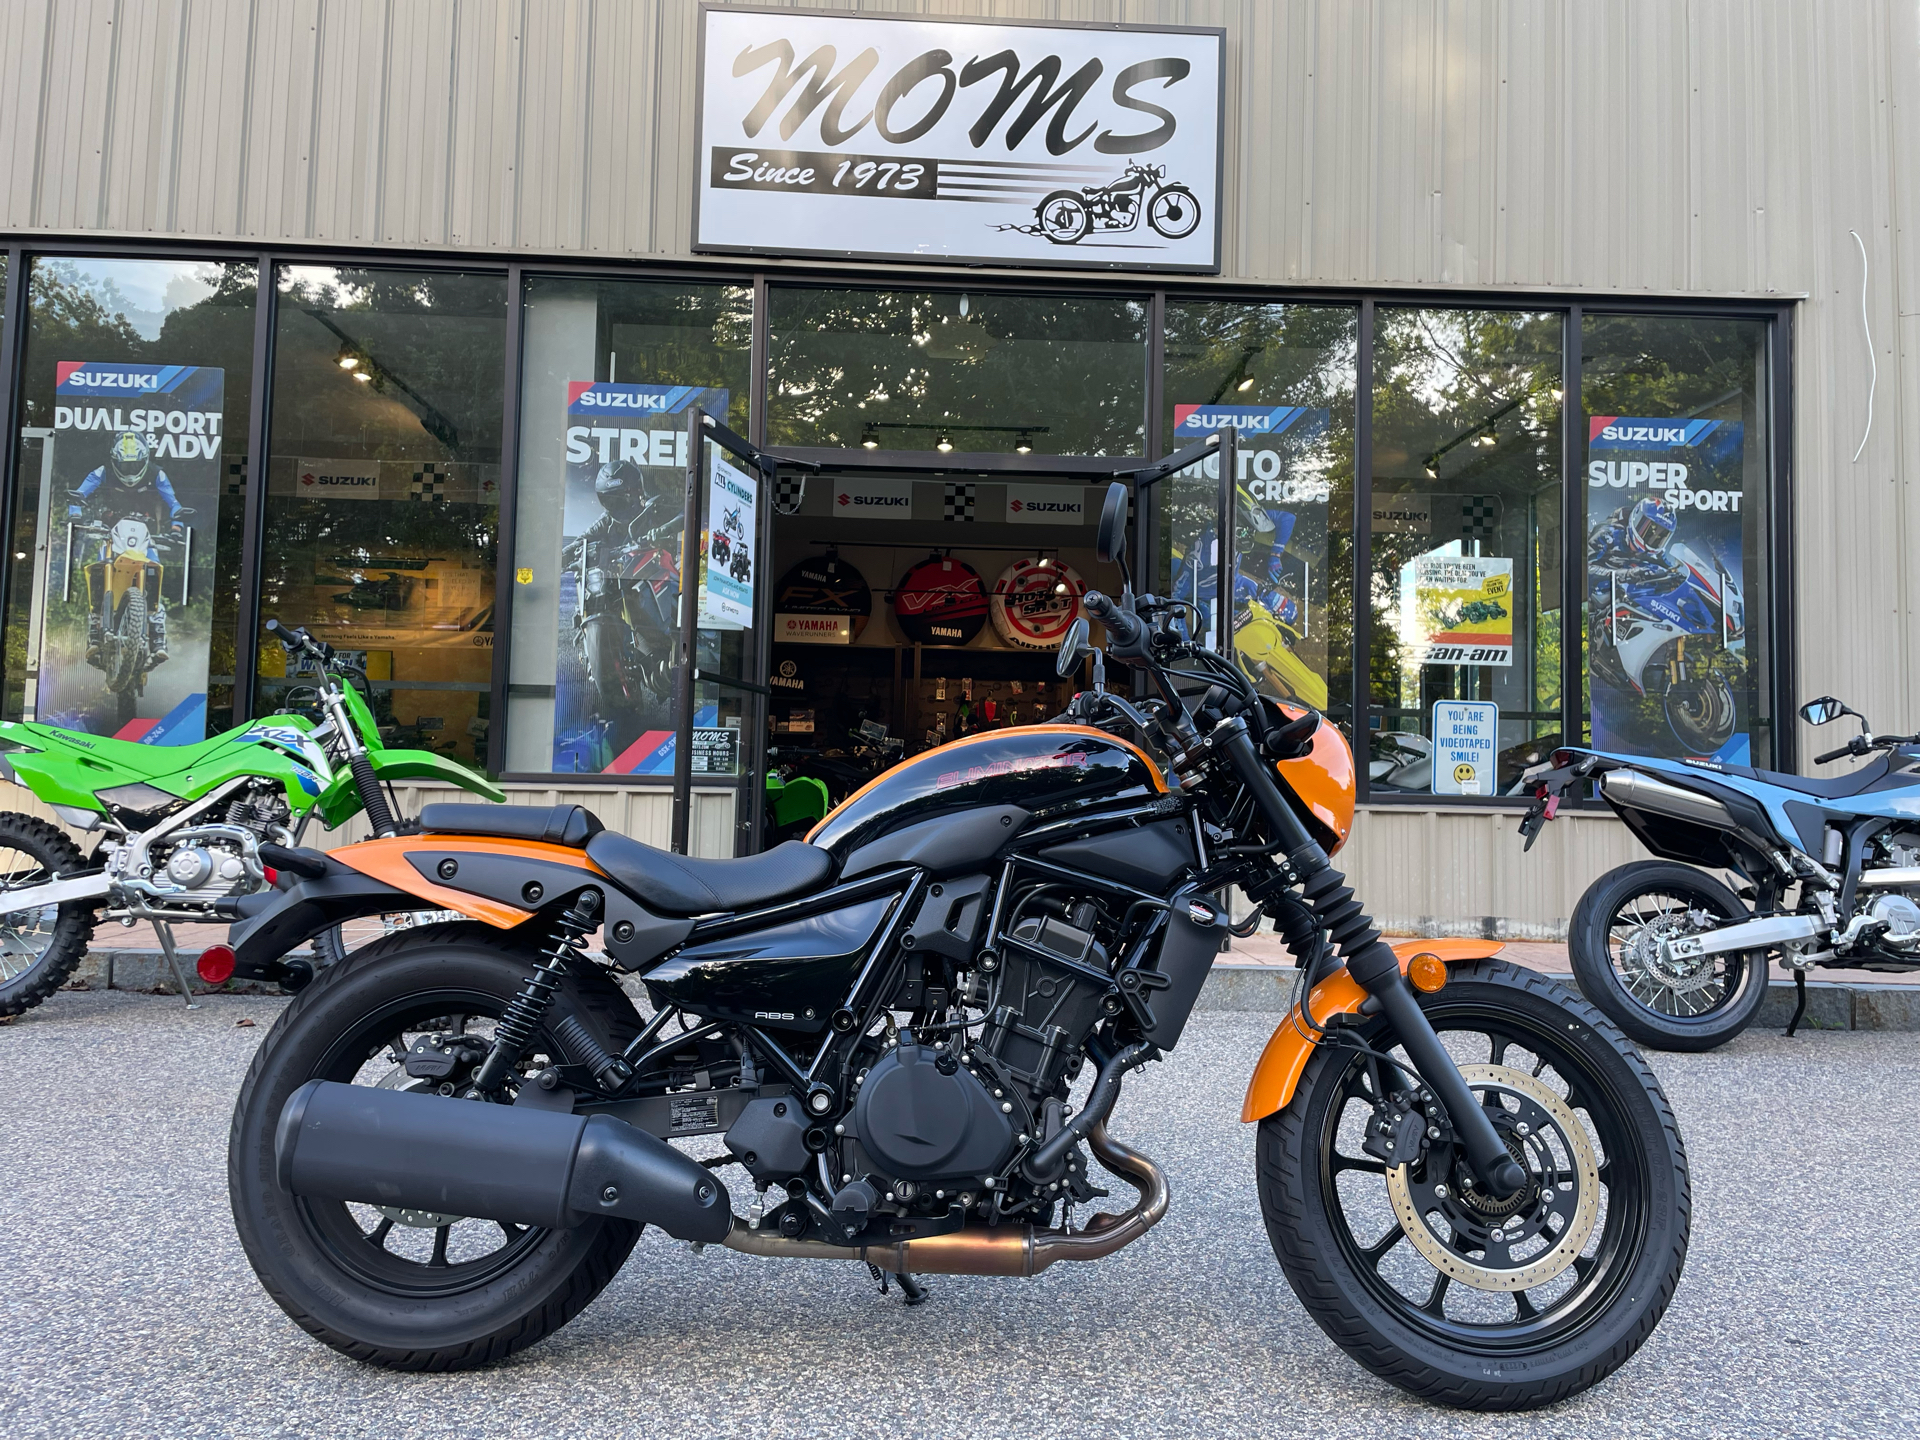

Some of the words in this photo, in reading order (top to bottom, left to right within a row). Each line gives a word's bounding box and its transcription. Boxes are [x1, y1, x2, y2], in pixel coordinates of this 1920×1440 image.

[732, 37, 1191, 156] MOMS
[723, 152, 816, 186] Since
[834, 158, 925, 191] 1973
[69, 371, 158, 389] SUZUKI
[580, 391, 666, 409] SUZUKI
[54, 406, 223, 435] DUALSPORT
[1186, 413, 1270, 429] SUZUKI
[1602, 426, 1685, 442] SUZUKI
[566, 425, 689, 467] STREE
[1173, 449, 1281, 481] MOTO
[318, 475, 376, 487] SUZUKI
[715, 473, 726, 488] ALL
[1588, 460, 1688, 489] SUPER
[727, 480, 753, 504] CYLINDERS
[853, 495, 909, 507] SUZUKI
[1026, 501, 1081, 513] SUZUKI
[1664, 489, 1743, 512] SPORT
[1372, 510, 1428, 522] SUZUKI
[801, 570, 827, 583] YAMAHA
[779, 586, 861, 608] FX
[1486, 585, 1504, 595] EVENT
[1650, 599, 1681, 623] SUZUKI
[798, 619, 839, 631] YAMAHA
[931, 626, 963, 638] YAMAHA
[785, 630, 836, 638] WAVERUNNERS
[769, 675, 804, 690] YAMAHA
[1448, 710, 1464, 722] YOU
[1467, 711, 1484, 722] ARE
[249, 724, 313, 750] KLX
[1452, 724, 1478, 735] BEING
[49, 728, 97, 750] Kawasaki
[1440, 737, 1491, 749] VIDEOTAPED
[1450, 751, 1479, 762] SMILE!
[1685, 758, 1723, 770] SUZUKI
[936, 751, 1088, 790] ELIMINATOR
[754, 1011, 795, 1020] ABS
